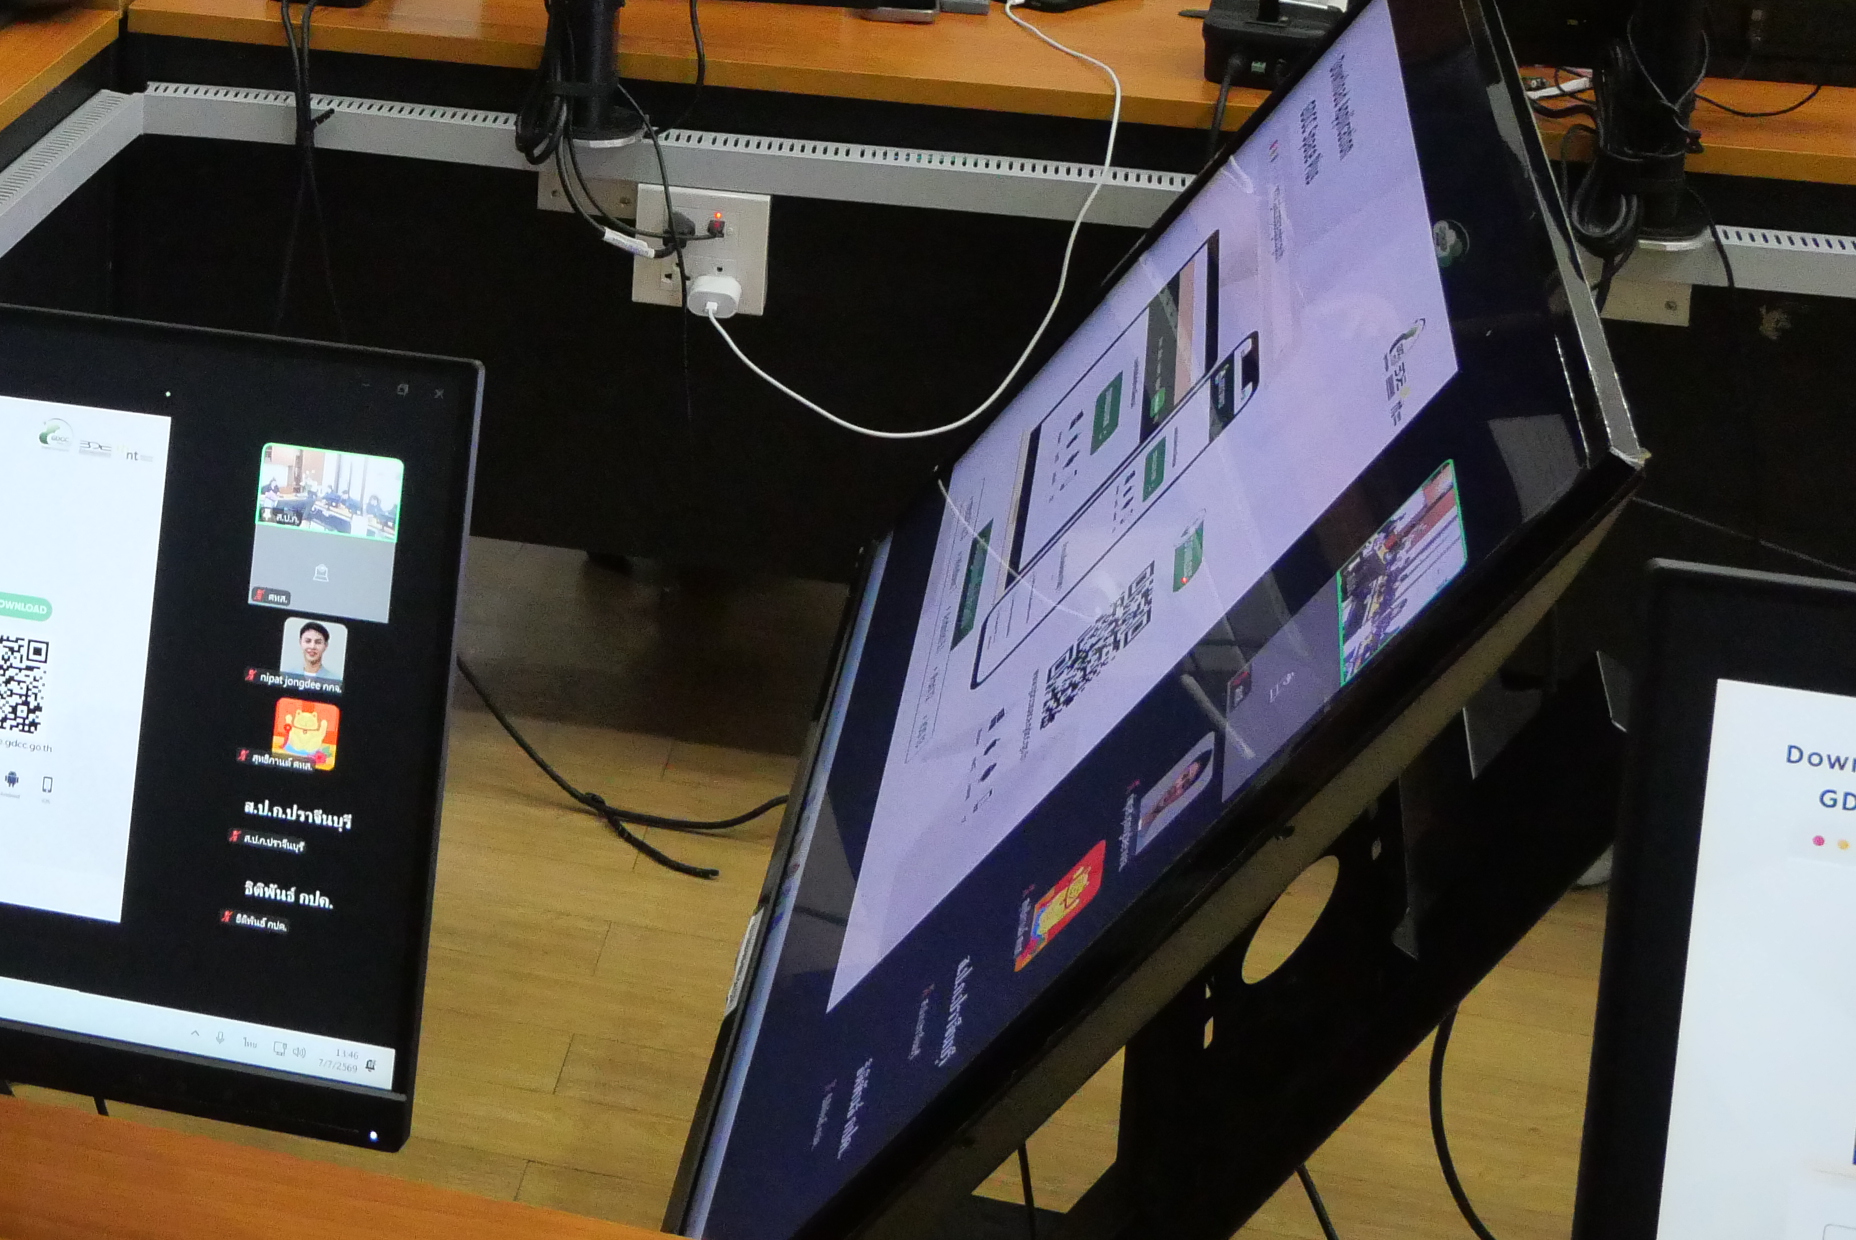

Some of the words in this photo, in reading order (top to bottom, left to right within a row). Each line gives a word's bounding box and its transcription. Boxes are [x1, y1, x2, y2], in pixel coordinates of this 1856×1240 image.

[126, 451, 138, 461] nt
[260, 672, 283, 685] nipat
[283, 676, 321, 690] jongdee
[244, 799, 352, 832] ส.ป.ก.ปราจีนบุรี
